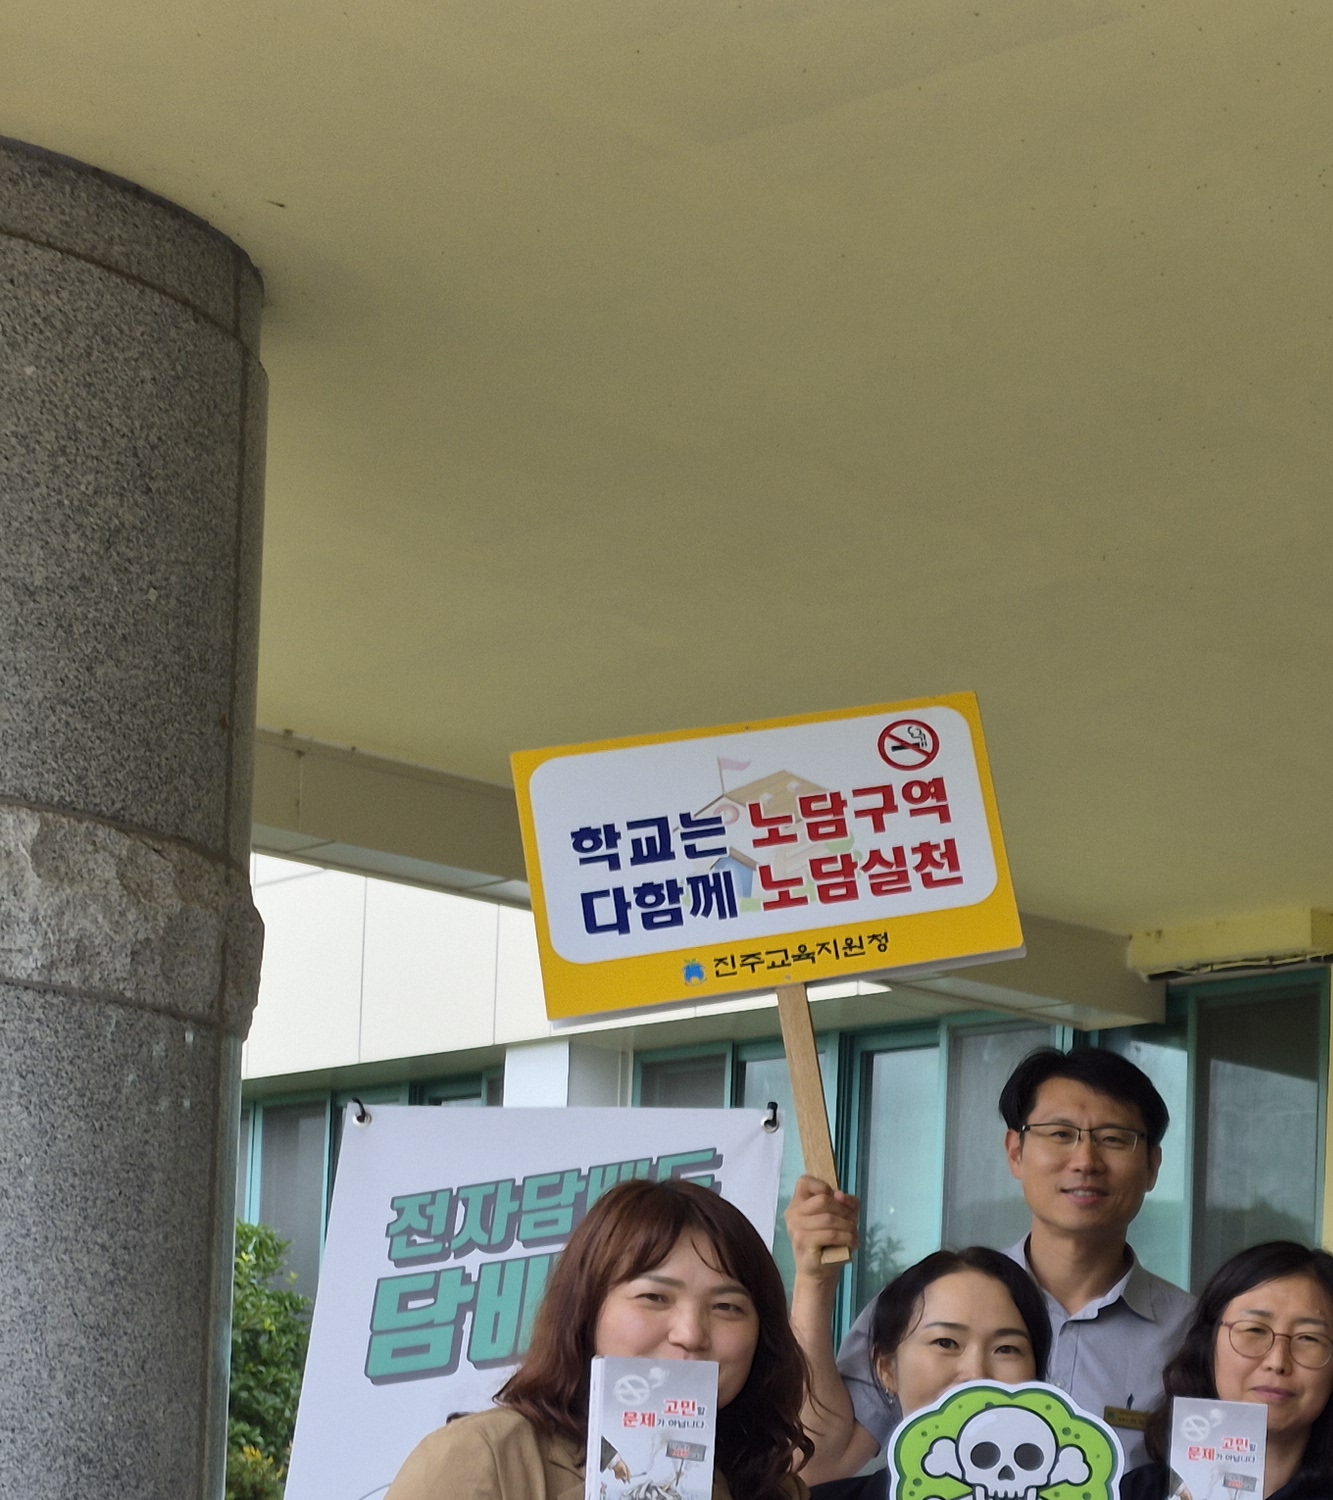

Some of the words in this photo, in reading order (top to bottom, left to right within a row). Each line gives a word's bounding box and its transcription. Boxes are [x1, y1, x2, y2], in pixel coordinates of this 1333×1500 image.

[571, 811, 729, 872] 학교는
[749, 777, 951, 849] 노담구역
[580, 872, 738, 936] 다함께
[758, 839, 964, 912] 노담실천
[713, 932, 889, 978] 진주교육지원청
[622, 1410, 665, 1428] 문제가
[663, 1399, 705, 1417] 고민할
